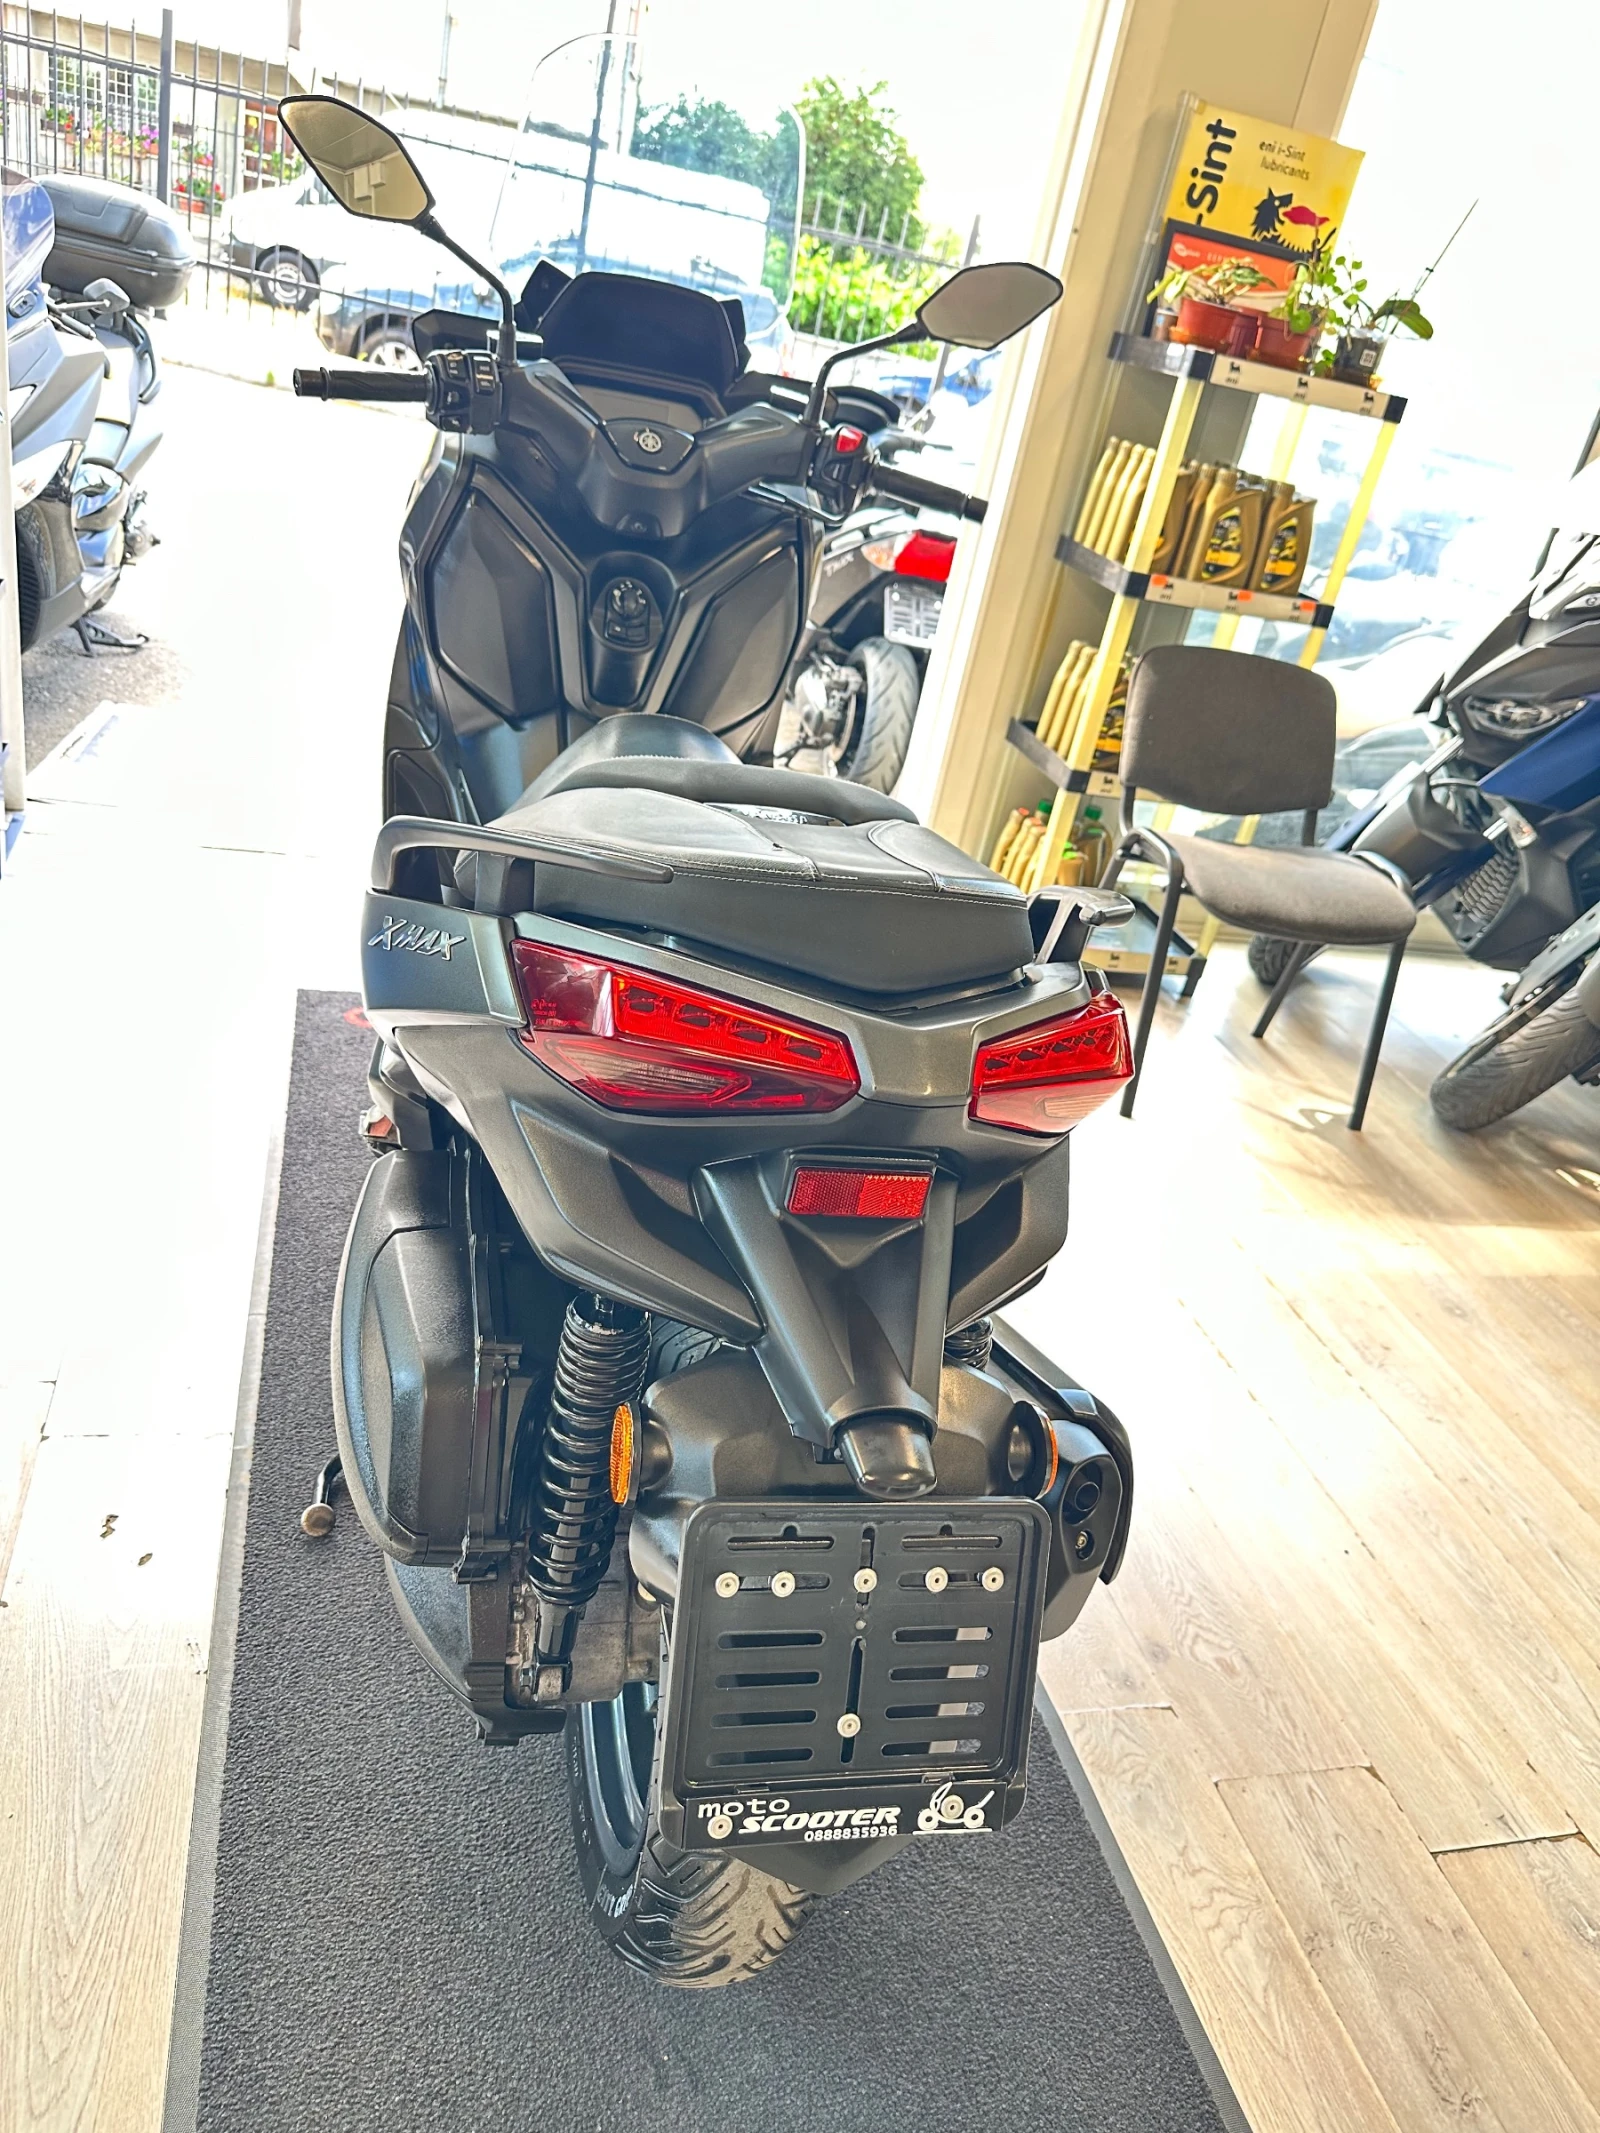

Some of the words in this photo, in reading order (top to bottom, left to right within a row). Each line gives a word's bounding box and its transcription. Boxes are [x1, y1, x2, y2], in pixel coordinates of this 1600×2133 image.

[1259, 140, 1276, 152] eni
[1277, 142, 1306, 163] i-Sint
[1260, 156, 1310, 181] lubricants
[697, 1798, 791, 1819] moto
[738, 1805, 902, 1835] SCOOTER
[803, 1825, 898, 1842] 0888835936
